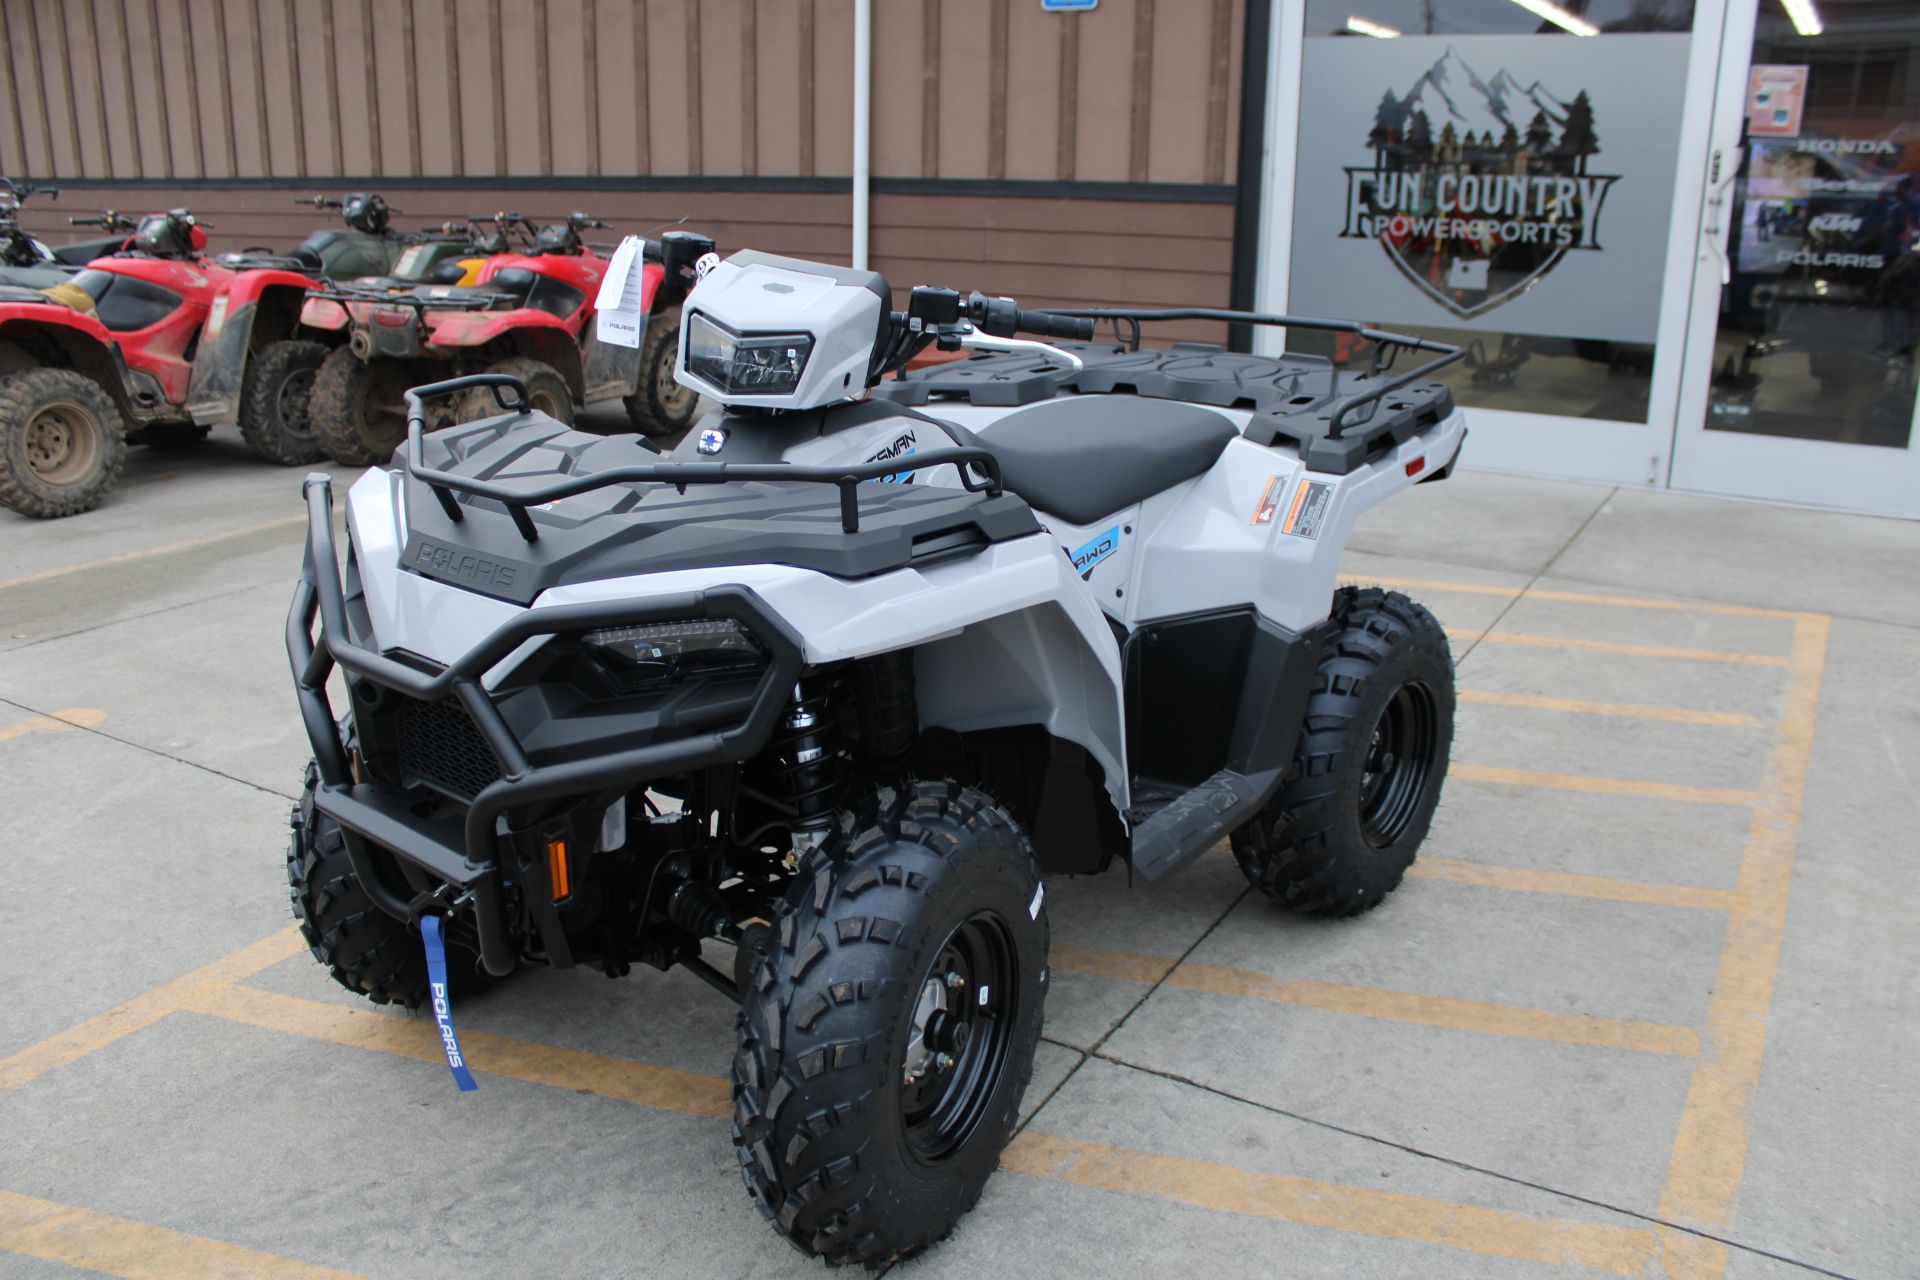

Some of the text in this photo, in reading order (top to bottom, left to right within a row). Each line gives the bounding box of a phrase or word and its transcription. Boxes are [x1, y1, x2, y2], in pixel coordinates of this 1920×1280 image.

[1797, 139, 1896, 154] HONDA
[1346, 168, 1612, 248] FUN COUNTRY
[1808, 213, 1863, 232] KTM
[1374, 215, 1573, 246] POWERSPORTS
[1776, 251, 1885, 269] POLARIS
[609, 321, 636, 333] POLARIS
[415, 542, 518, 589] POLARIS
[1074, 539, 1112, 570] AWD
[431, 982, 464, 1069] POLARIS
